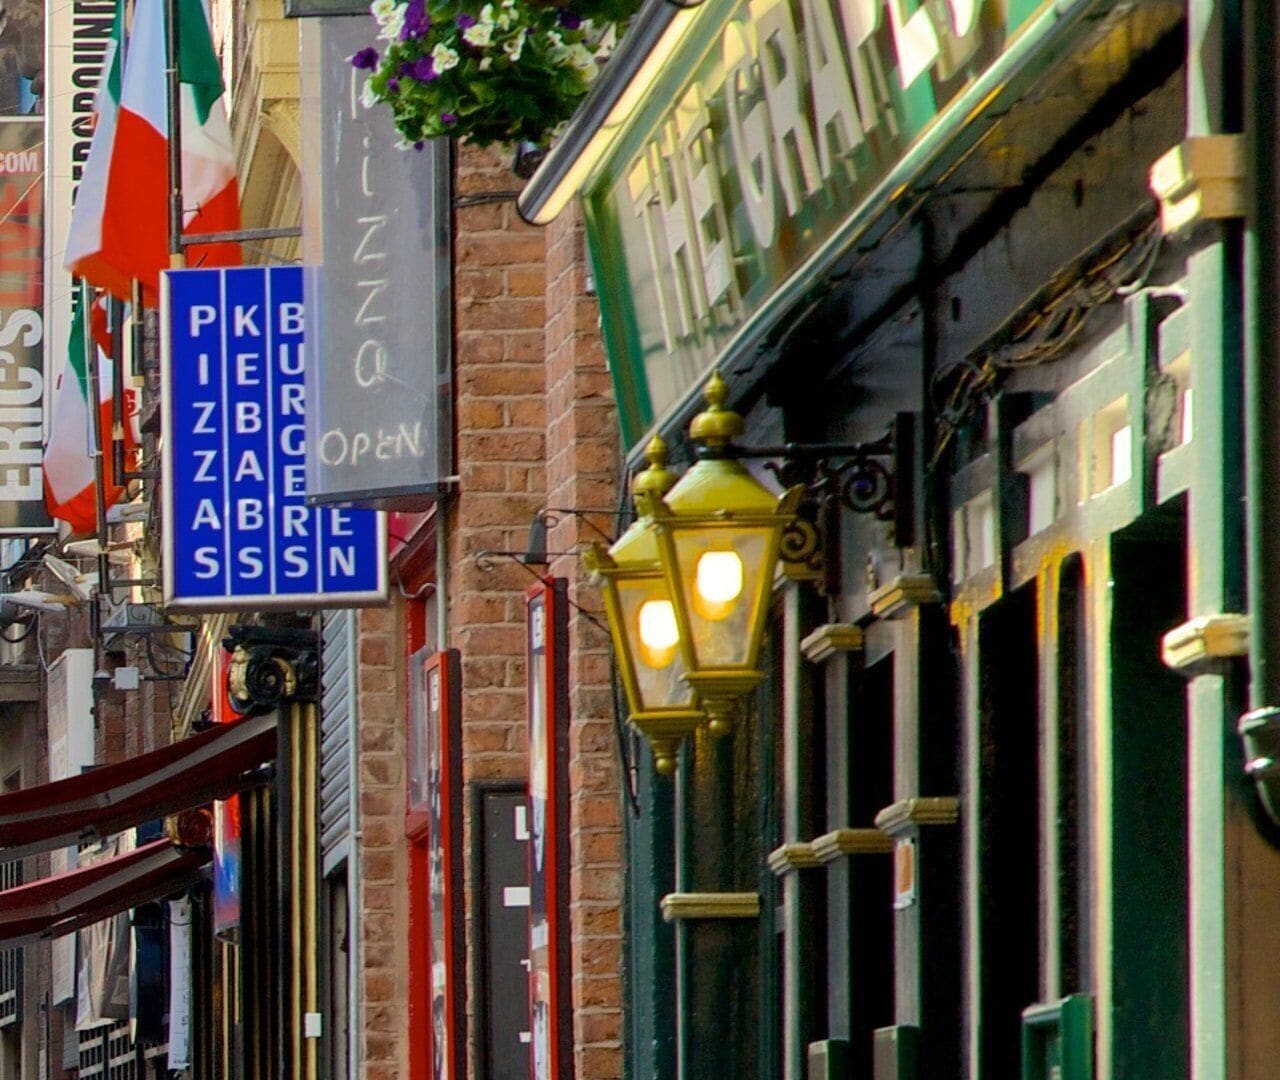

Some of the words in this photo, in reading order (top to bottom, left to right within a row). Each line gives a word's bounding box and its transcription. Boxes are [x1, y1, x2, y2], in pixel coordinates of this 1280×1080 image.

[628, 82, 742, 354] THE
[190, 304, 222, 580] PIZZAS
[233, 303, 266, 579] KEBABS
[278, 301, 311, 579] BURGERS
